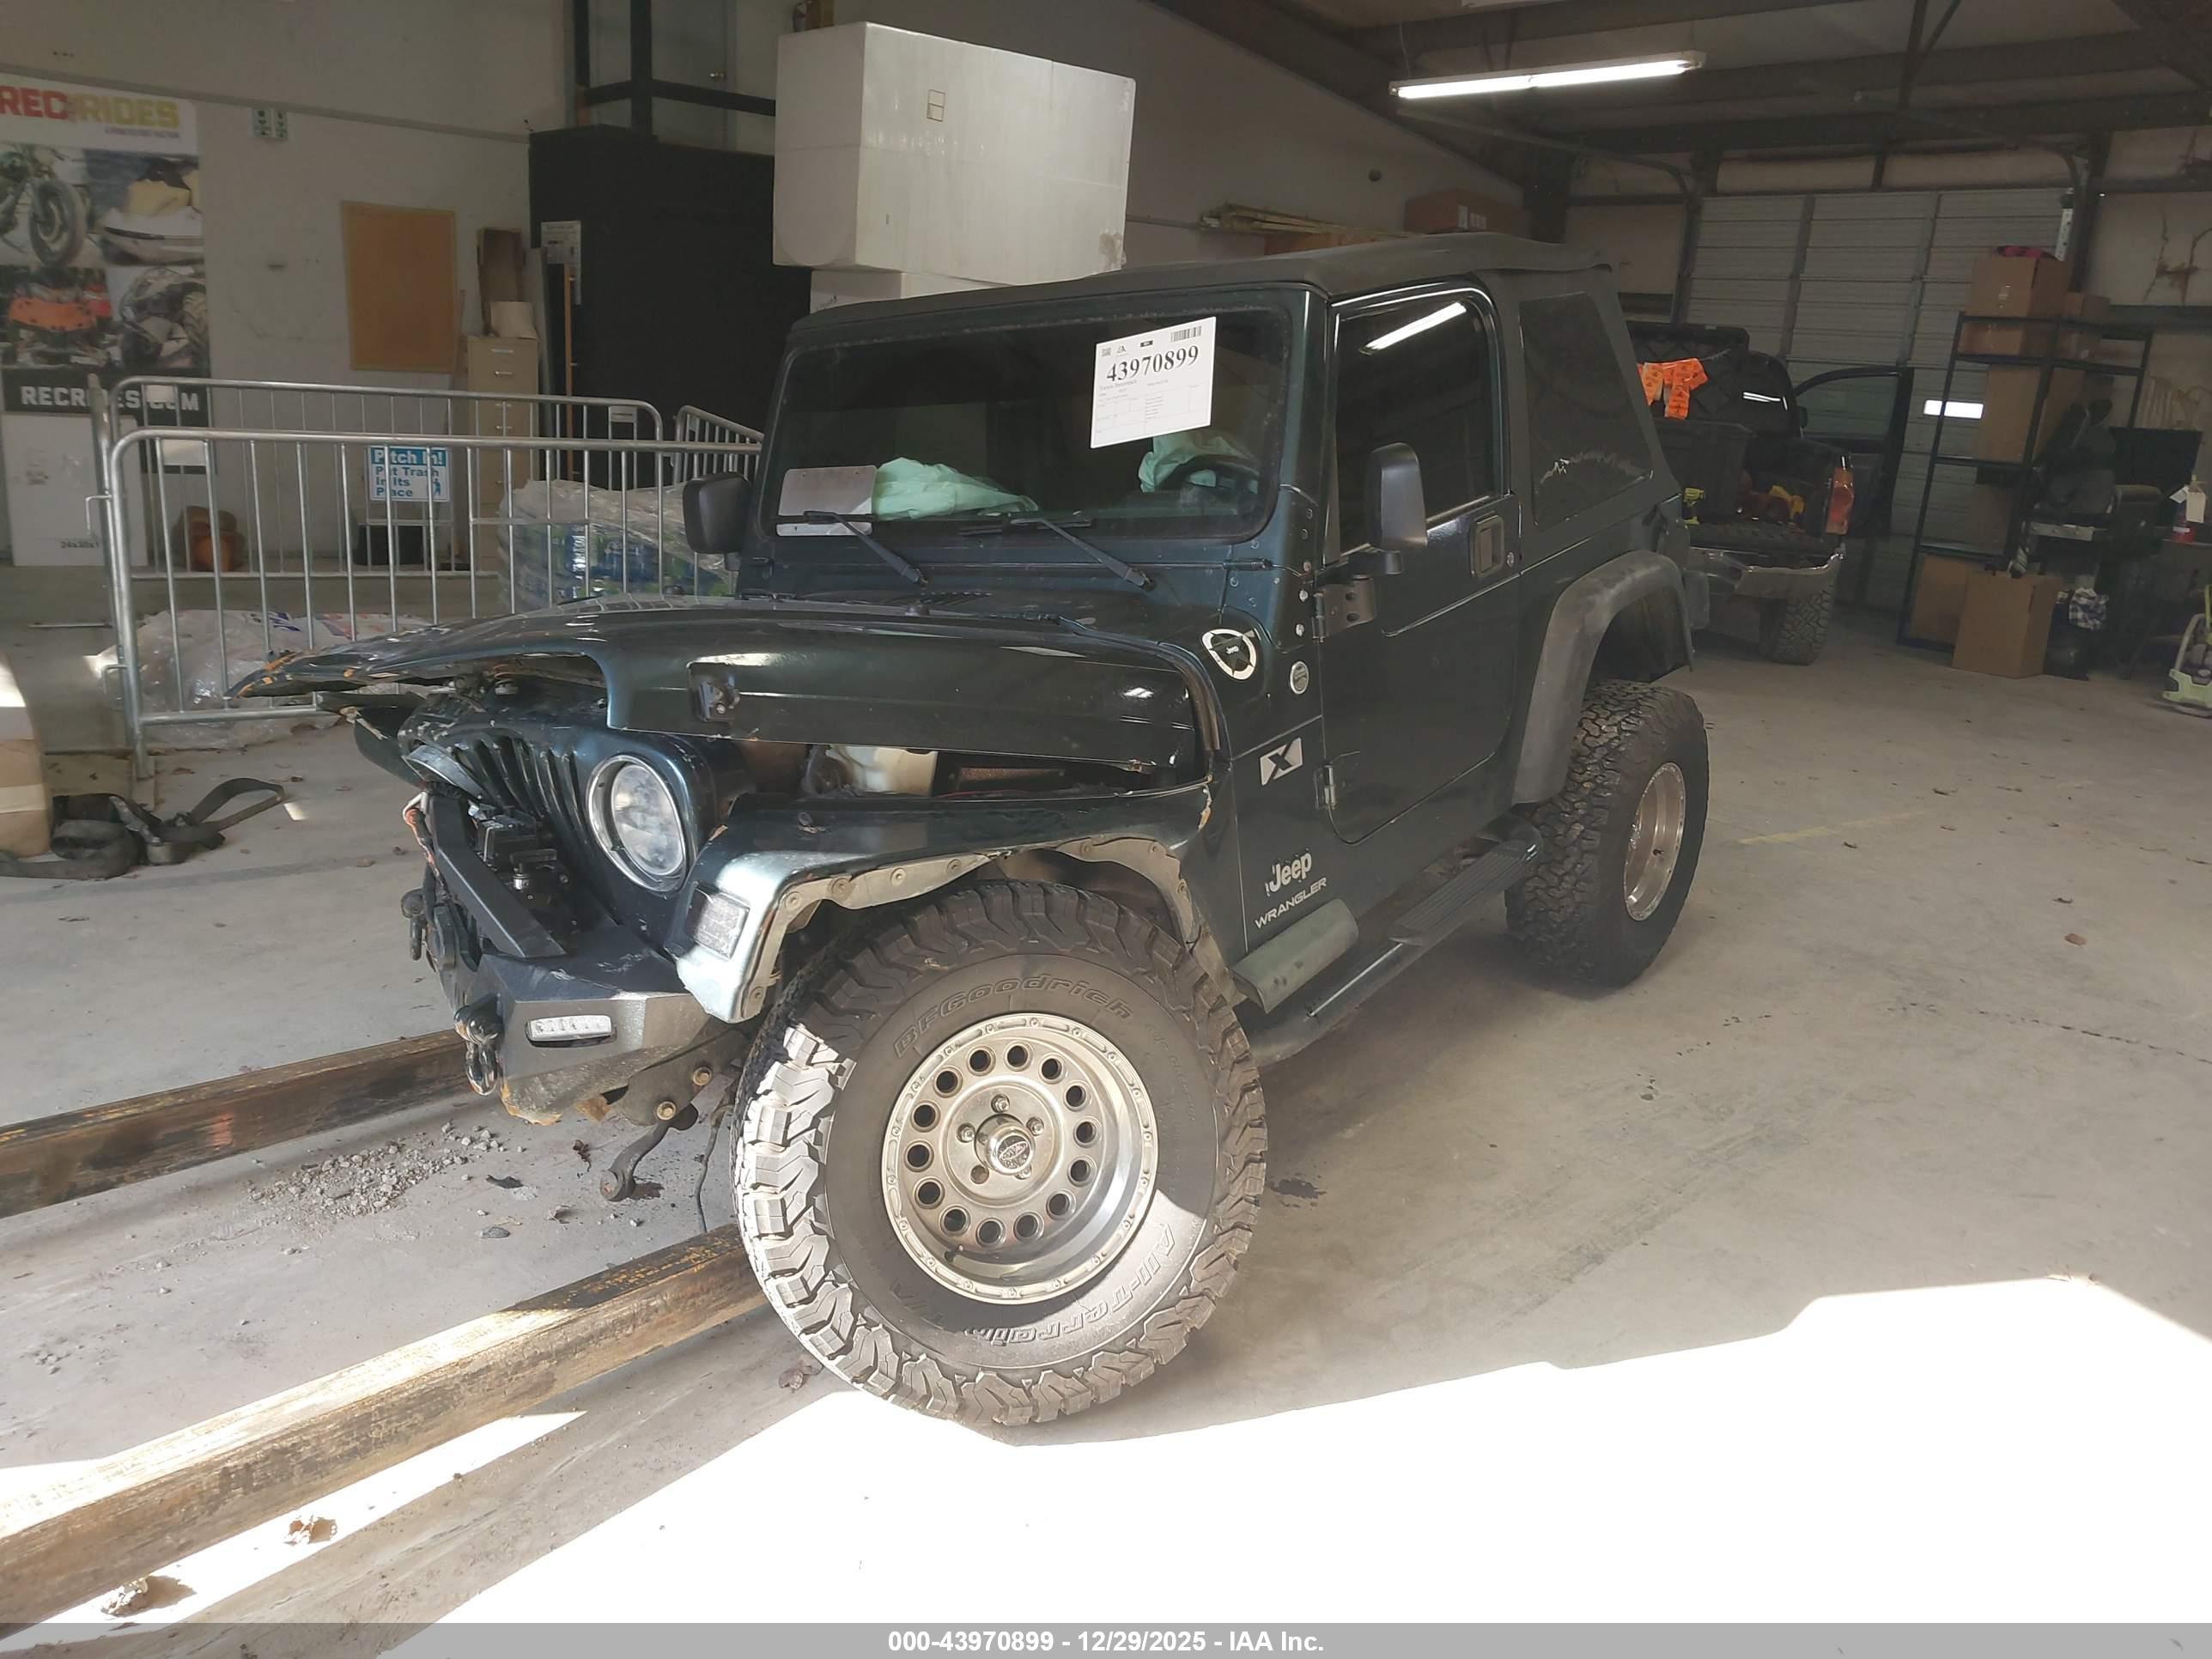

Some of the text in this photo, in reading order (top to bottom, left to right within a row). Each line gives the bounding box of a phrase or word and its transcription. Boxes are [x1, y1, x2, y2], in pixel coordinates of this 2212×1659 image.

[0, 86, 69, 119] REC
[76, 93, 180, 129] RIDES
[1106, 344, 1200, 382] 43970899
[374, 449, 417, 464] Ptch
[375, 465, 398, 476] Pt
[376, 487, 413, 497] Pace
[1268, 852, 1312, 892] Jeep
[1255, 877, 1327, 929] WRANGLER
